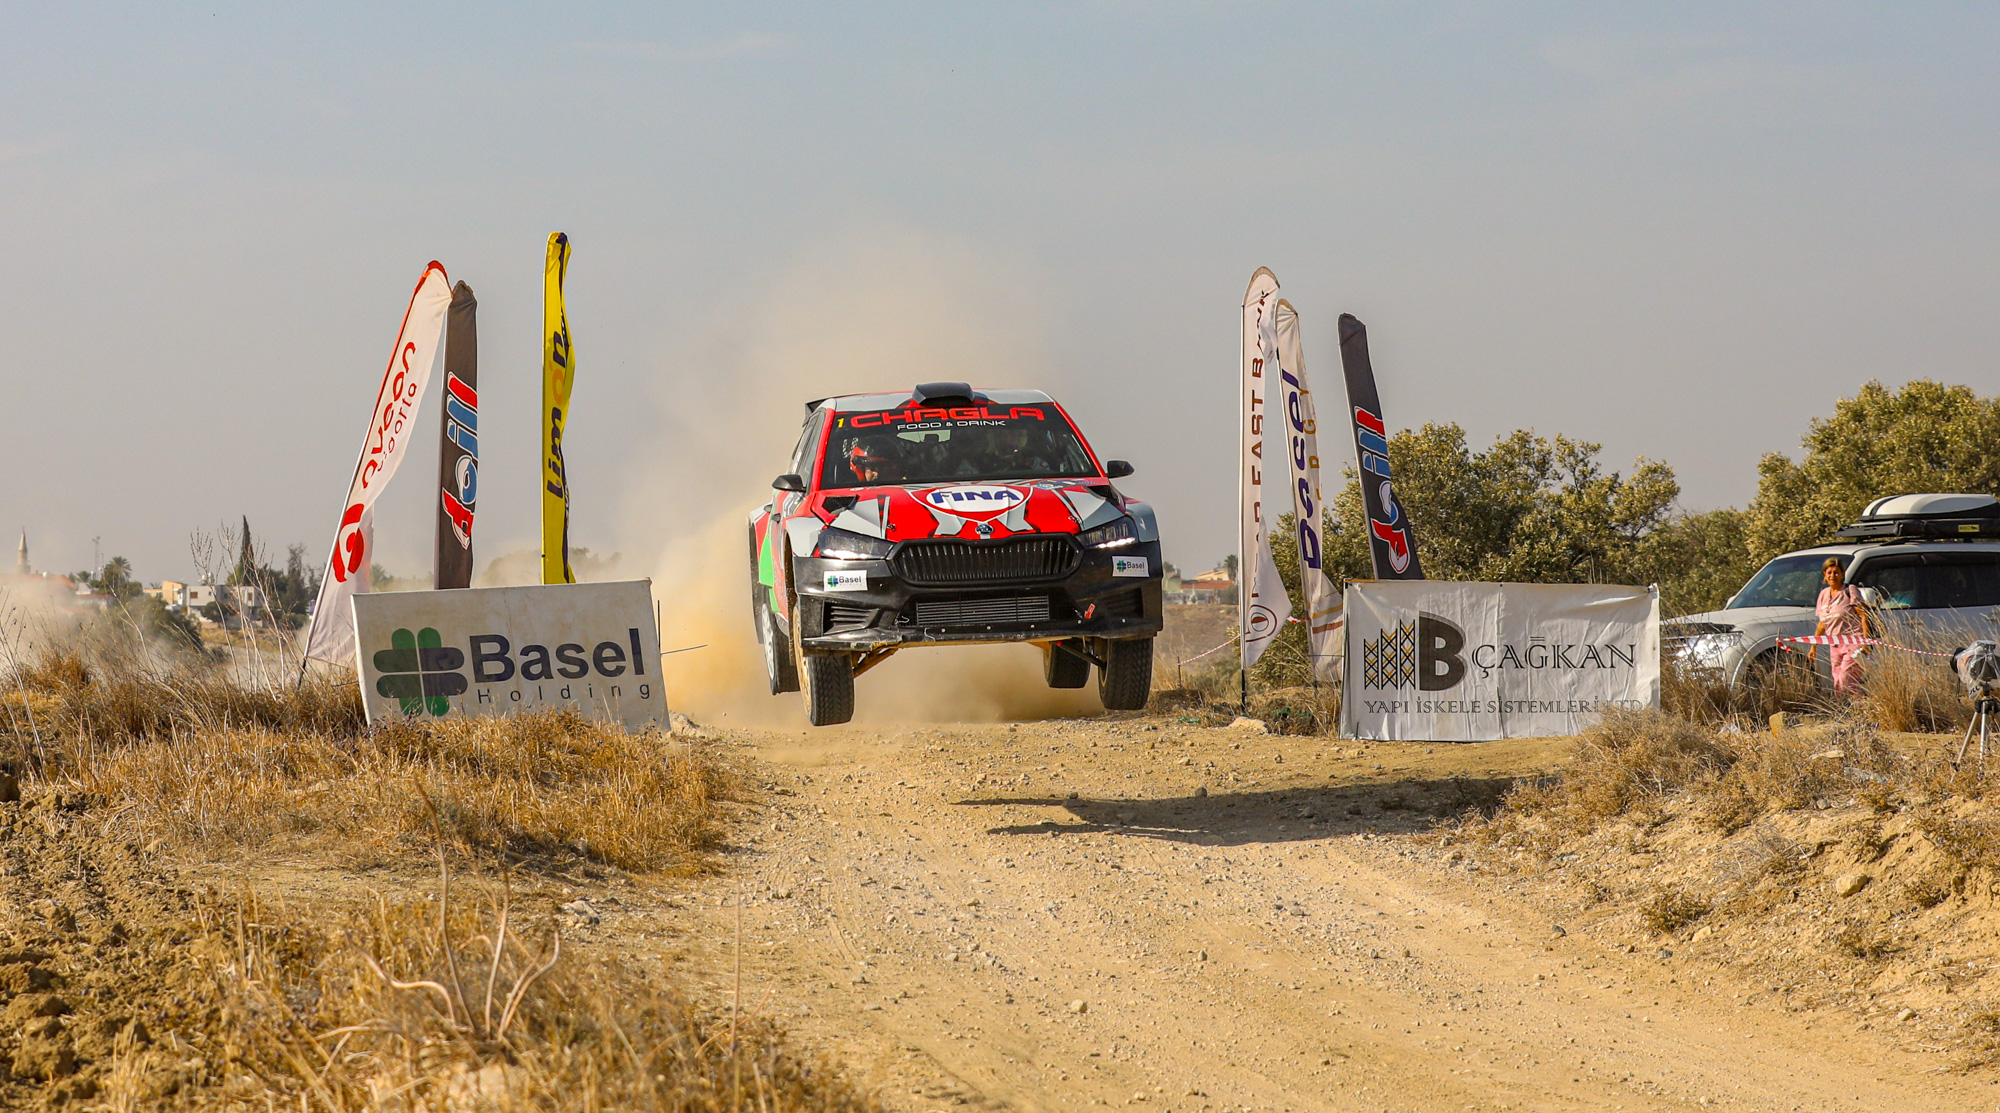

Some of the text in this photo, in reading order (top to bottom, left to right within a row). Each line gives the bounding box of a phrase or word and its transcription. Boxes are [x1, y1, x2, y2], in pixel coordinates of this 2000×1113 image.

[361, 341, 416, 489] aveon
[836, 418, 845, 428] 1
[850, 407, 1045, 428] CHAGLA
[897, 421, 942, 430] FOOD
[931, 490, 1021, 504] FINA
[1126, 561, 1145, 570] Basel
[838, 575, 862, 583] Basel
[469, 628, 645, 683] Basel
[477, 683, 650, 704] Holding
[1364, 700, 1410, 714] YAPI
[1416, 696, 1481, 714] İSKELE
